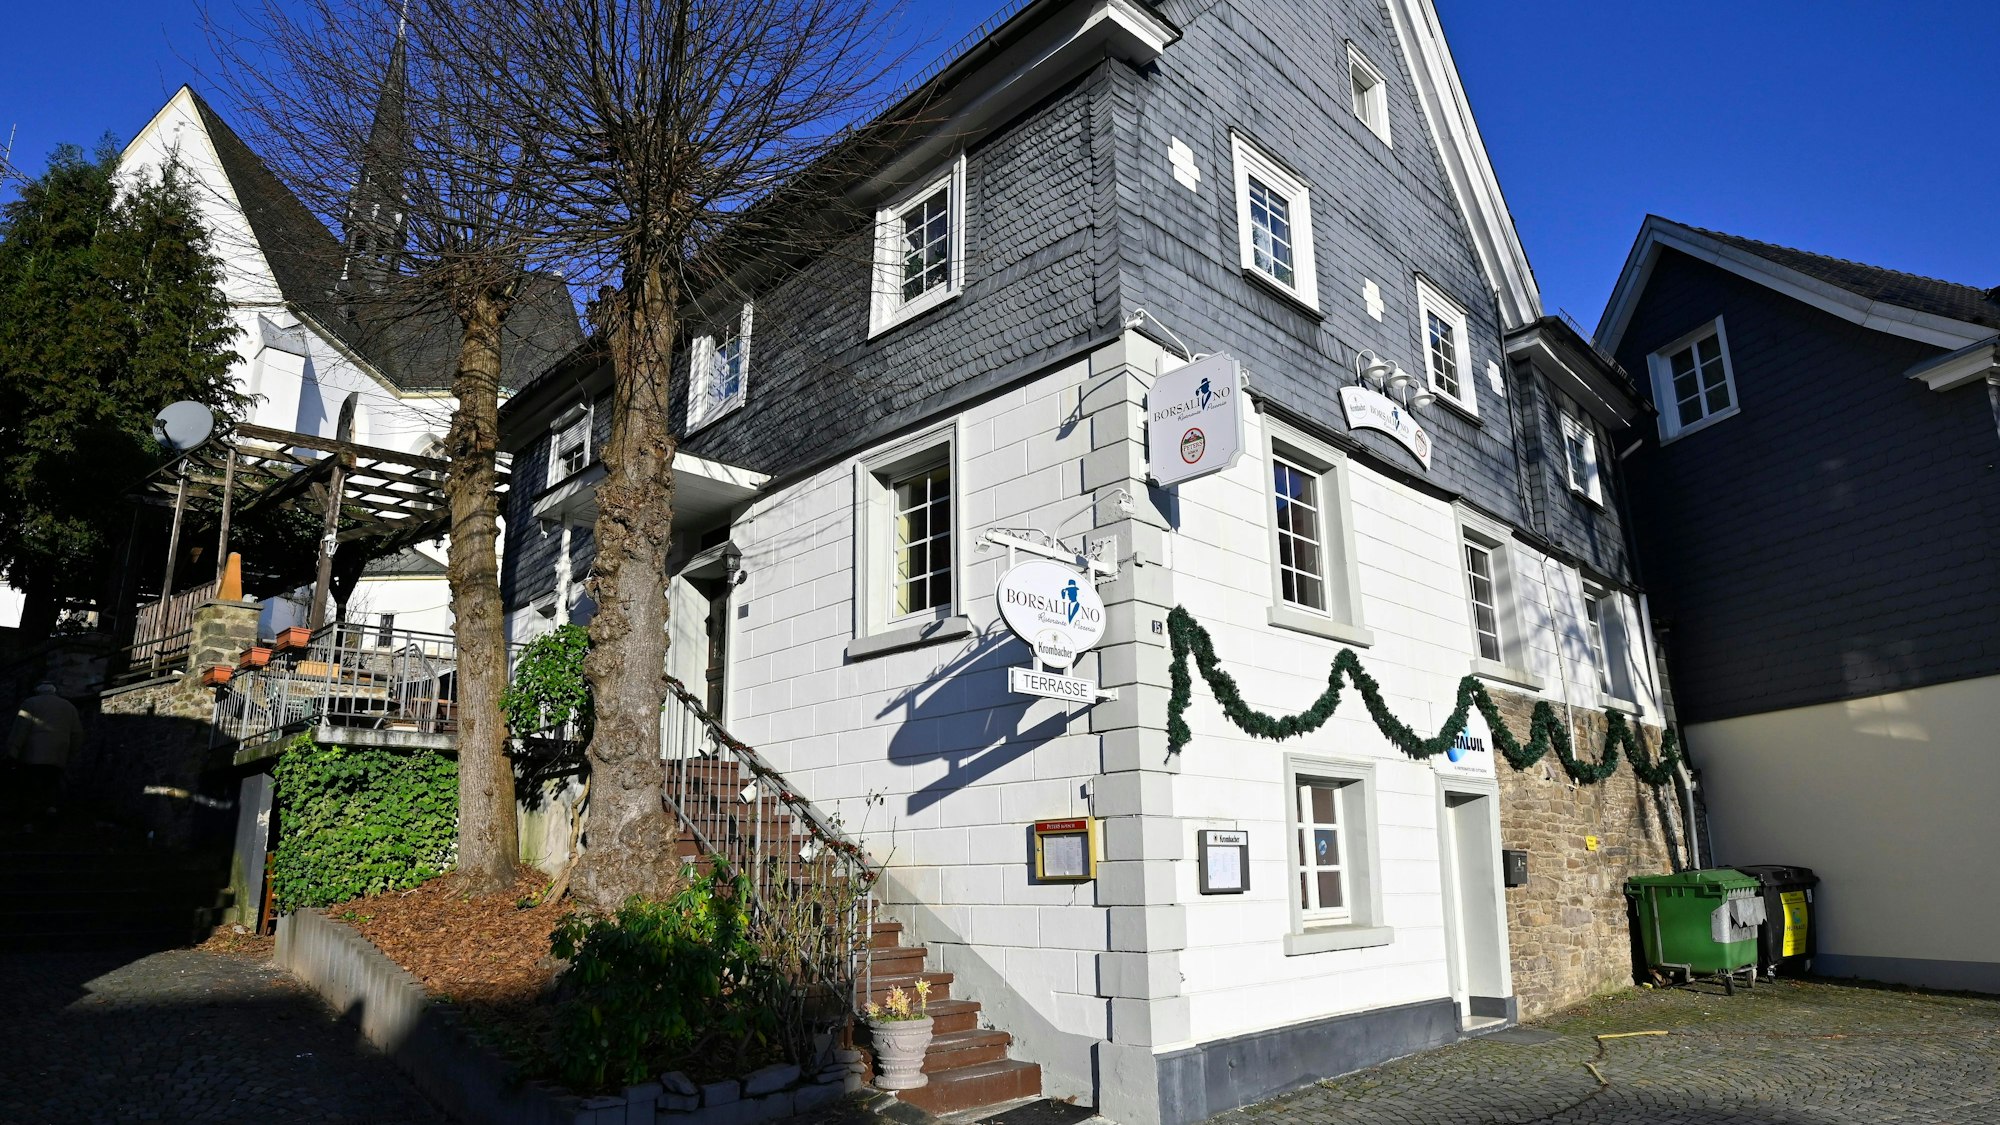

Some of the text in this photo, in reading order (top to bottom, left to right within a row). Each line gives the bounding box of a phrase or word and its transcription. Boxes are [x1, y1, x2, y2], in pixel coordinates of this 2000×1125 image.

[1153, 621, 1161, 634] 15
[1038, 640, 1073, 659] Krombacher
[1023, 673, 1088, 698] TERRASSE
[1455, 735, 1485, 752] TALUIL
